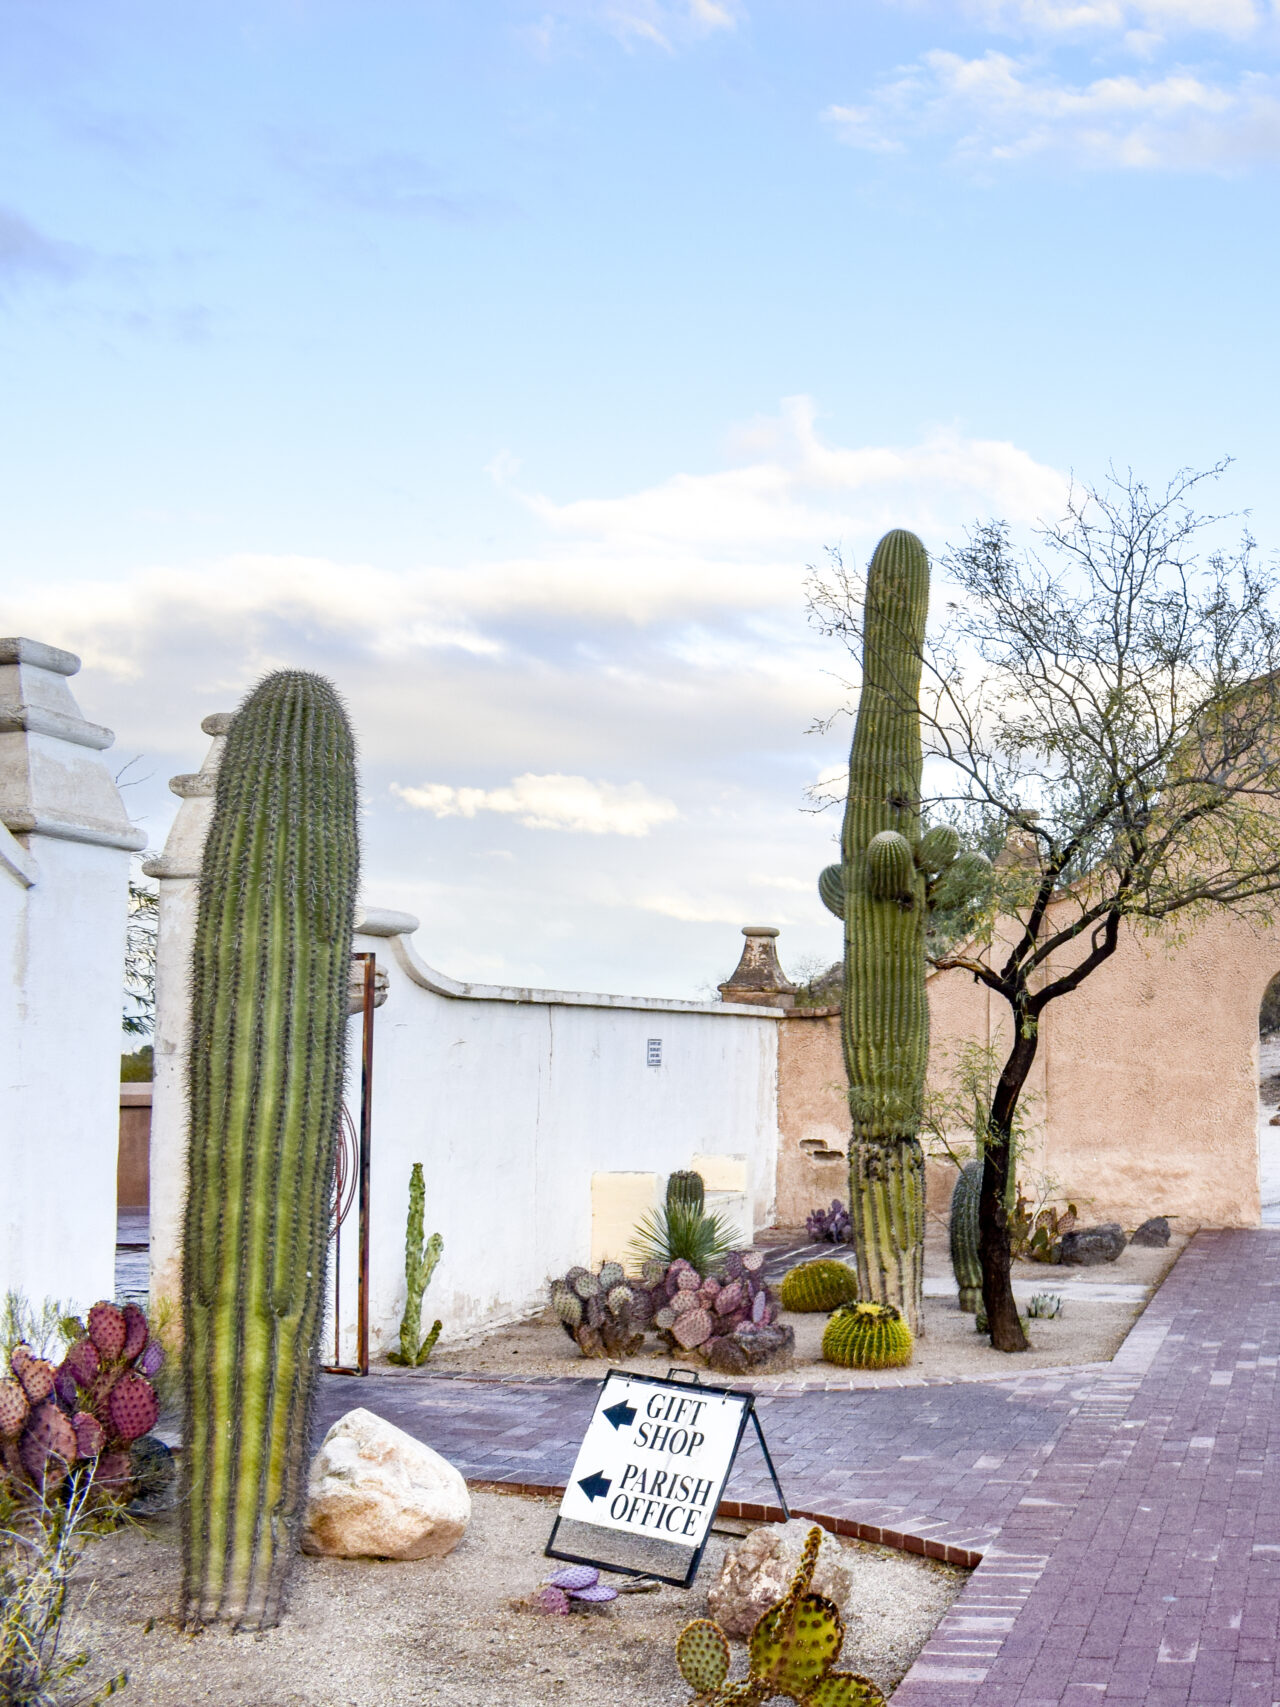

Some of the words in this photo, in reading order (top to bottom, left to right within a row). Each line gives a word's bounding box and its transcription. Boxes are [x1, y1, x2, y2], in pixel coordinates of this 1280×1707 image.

[646, 1393, 707, 1426] GIFT
[633, 1422, 705, 1457] SHOP
[618, 1464, 714, 1507] PARISH
[610, 1494, 702, 1537] OFFICE
